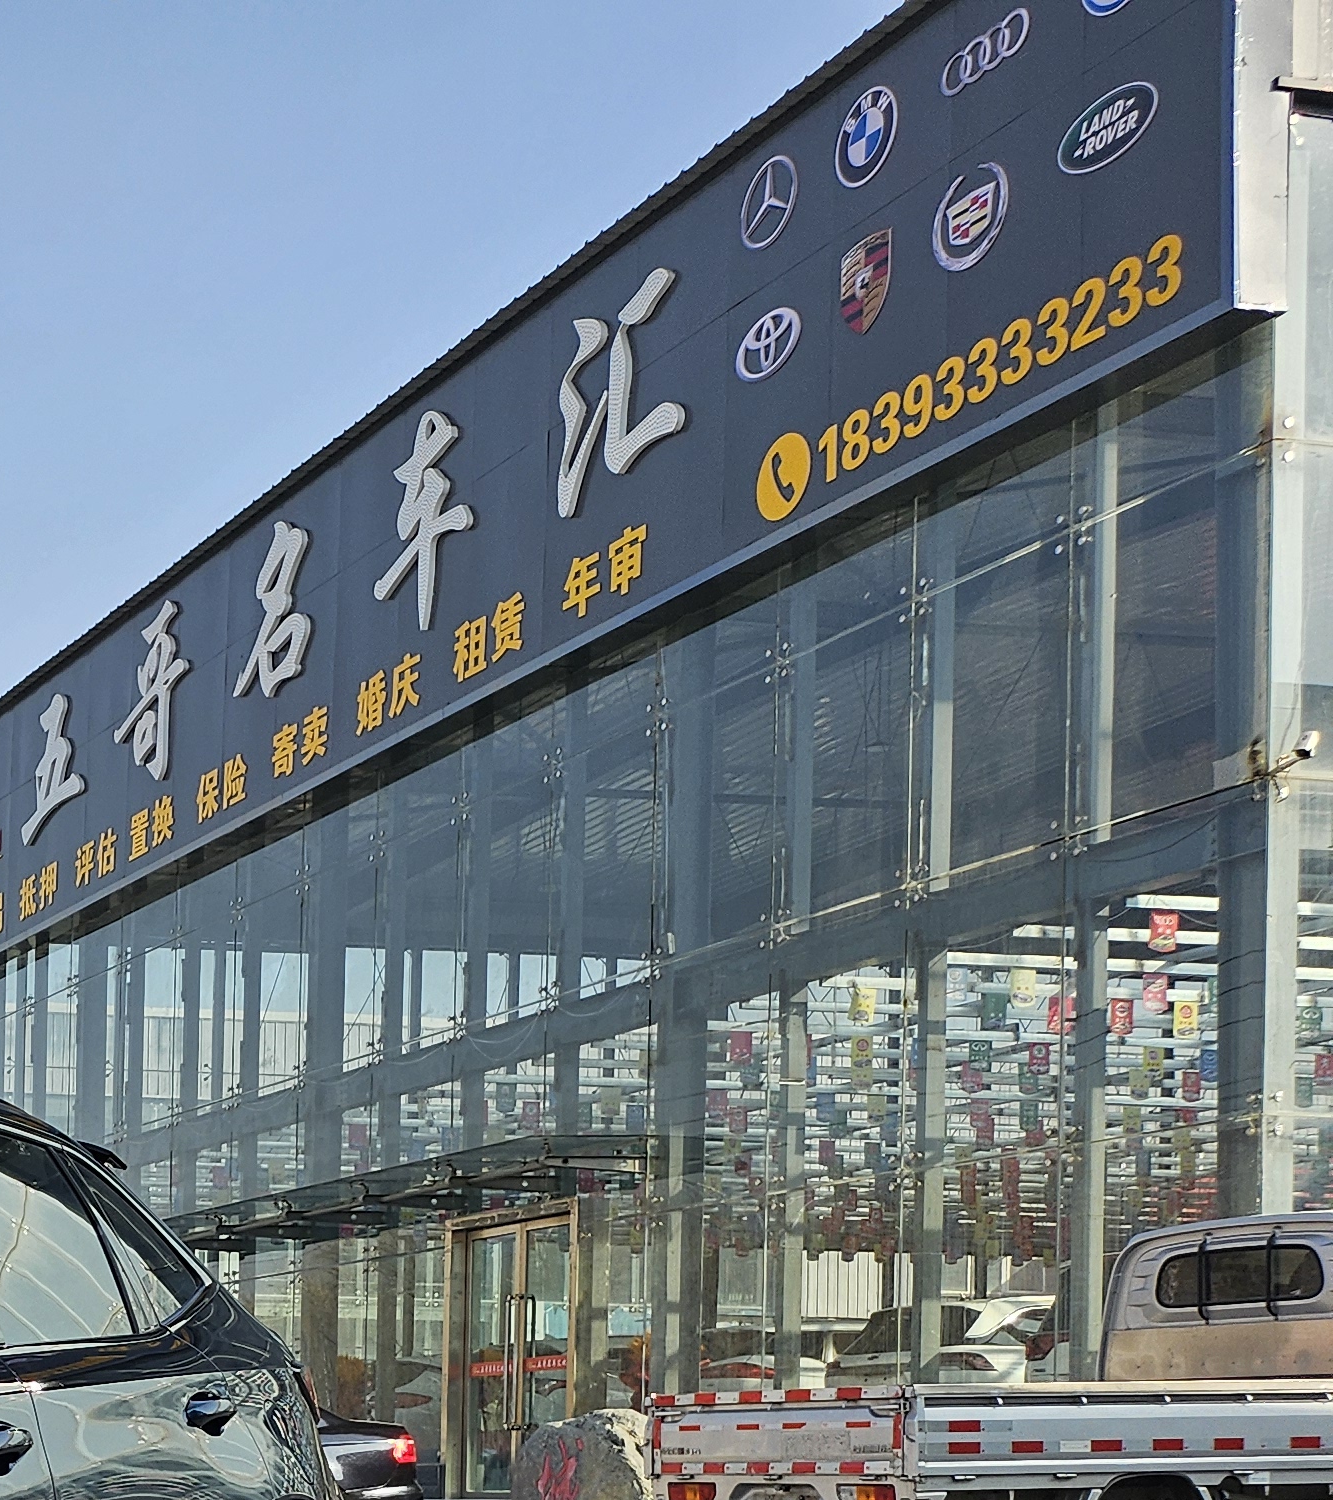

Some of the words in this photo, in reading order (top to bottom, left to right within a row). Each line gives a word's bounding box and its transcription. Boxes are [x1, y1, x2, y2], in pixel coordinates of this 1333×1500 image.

[844, 91, 892, 134] BMW
[1078, 98, 1126, 142] LAND
[1082, 109, 1139, 159] ROVER
[817, 233, 1183, 484] 18393333233
[21, 267, 686, 847] 五哥名车汇
[19, 861, 58, 921] 抵押
[74, 827, 118, 888] 评估
[128, 795, 175, 862] 置换
[196, 753, 248, 824] 保险
[271, 705, 329, 778] 寄卖
[355, 652, 422, 736] 婚庆
[452, 591, 525, 683] 租赁
[562, 523, 647, 617] 年审
